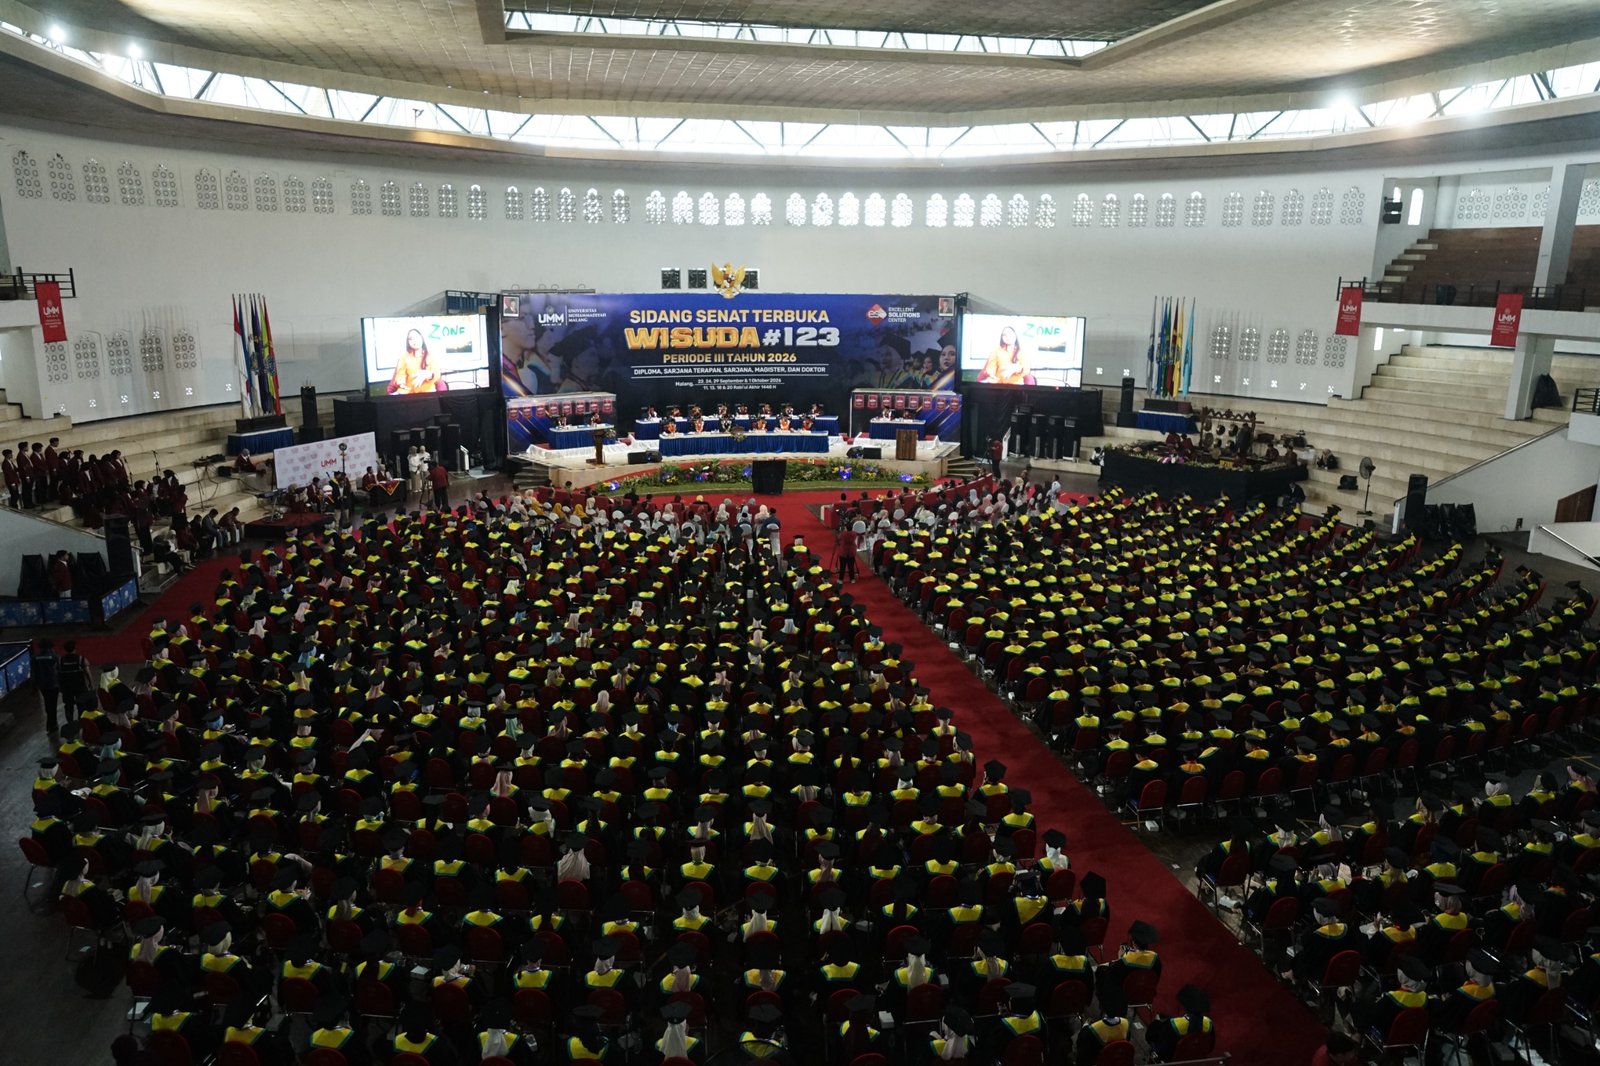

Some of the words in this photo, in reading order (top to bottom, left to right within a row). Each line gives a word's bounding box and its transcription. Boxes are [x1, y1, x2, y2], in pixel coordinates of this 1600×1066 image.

[42, 306, 60, 316] UMM
[630, 309, 693, 323] SIDANG
[696, 309, 750, 323] SENAT
[752, 309, 830, 323] TERBUKA
[538, 313, 564, 323] UMM
[1498, 313, 1516, 322] UMM
[624, 326, 760, 349] WISUDA
[762, 326, 840, 346] #123
[663, 353, 712, 364] PERIODE
[714, 353, 725, 363] III
[727, 353, 765, 363] TAHUN
[767, 353, 797, 363] 2026
[320, 458, 337, 467] UMM
